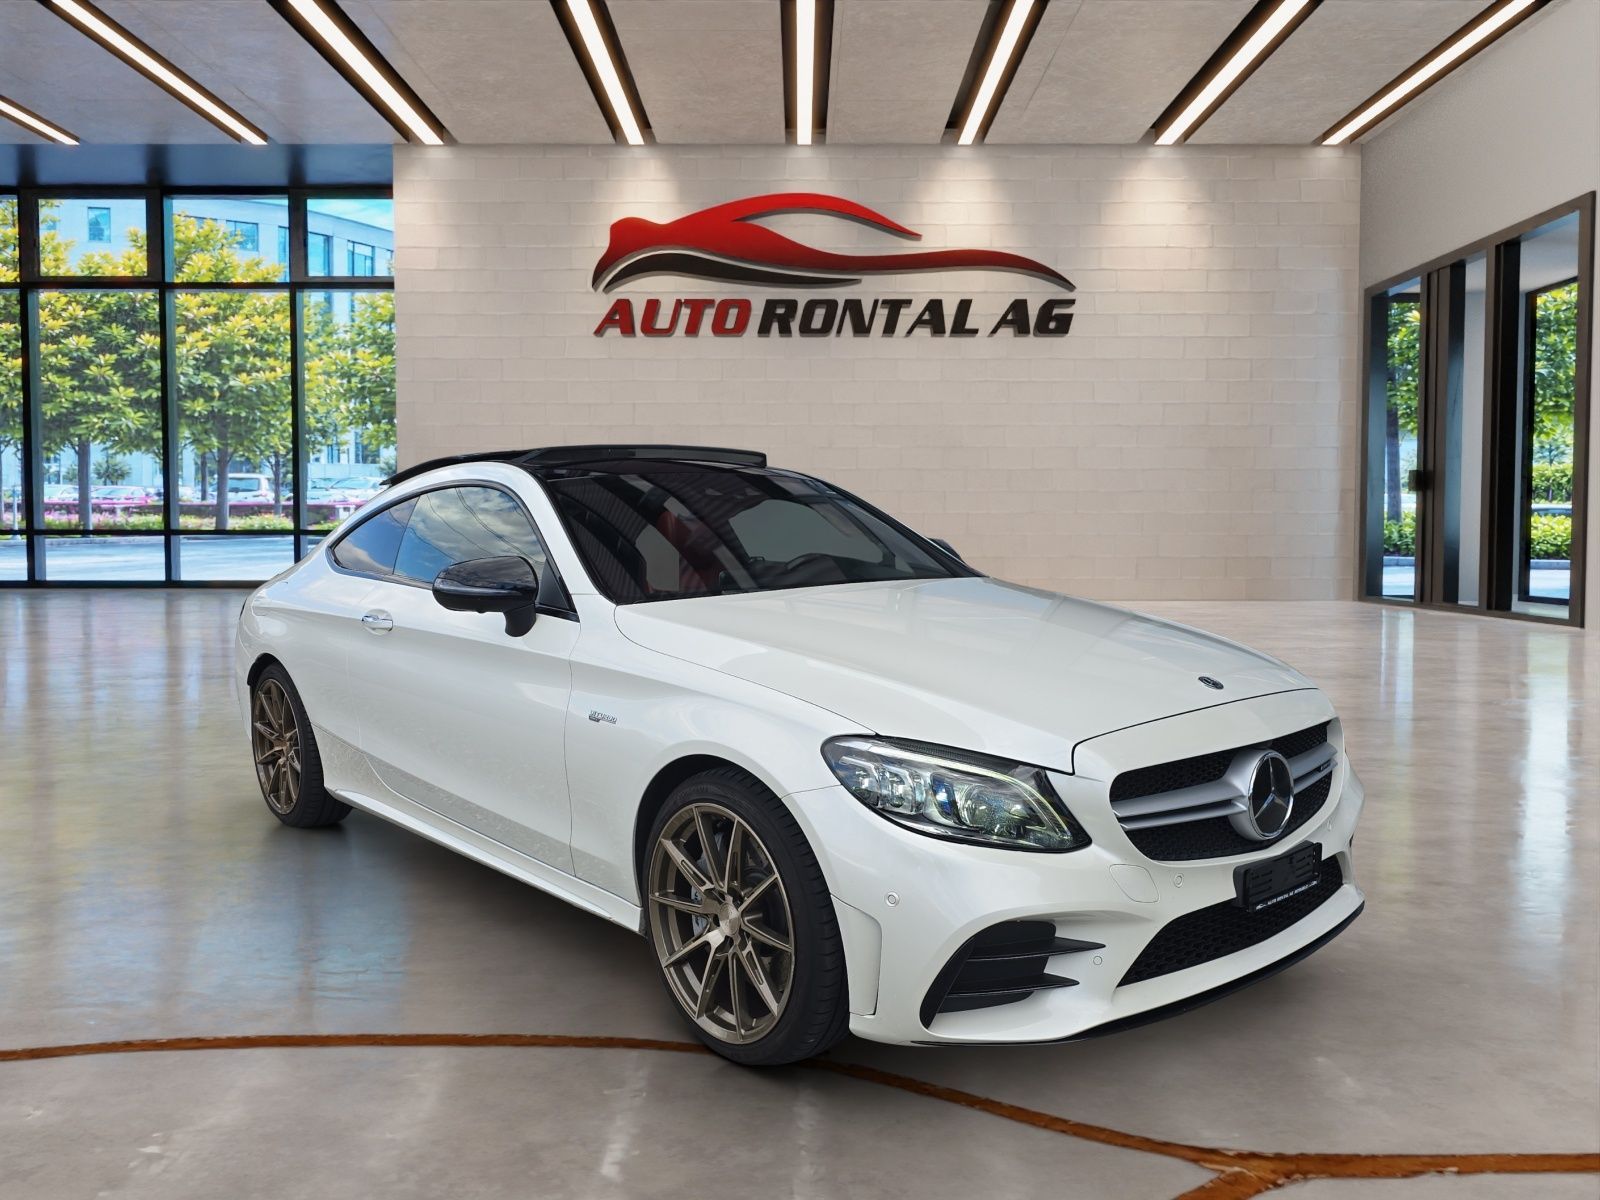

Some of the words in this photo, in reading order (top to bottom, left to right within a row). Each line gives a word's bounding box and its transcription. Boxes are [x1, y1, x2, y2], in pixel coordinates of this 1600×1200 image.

[593, 298, 752, 337] AUTO
[757, 298, 980, 338] RONTAL
[987, 298, 1077, 338] AG
